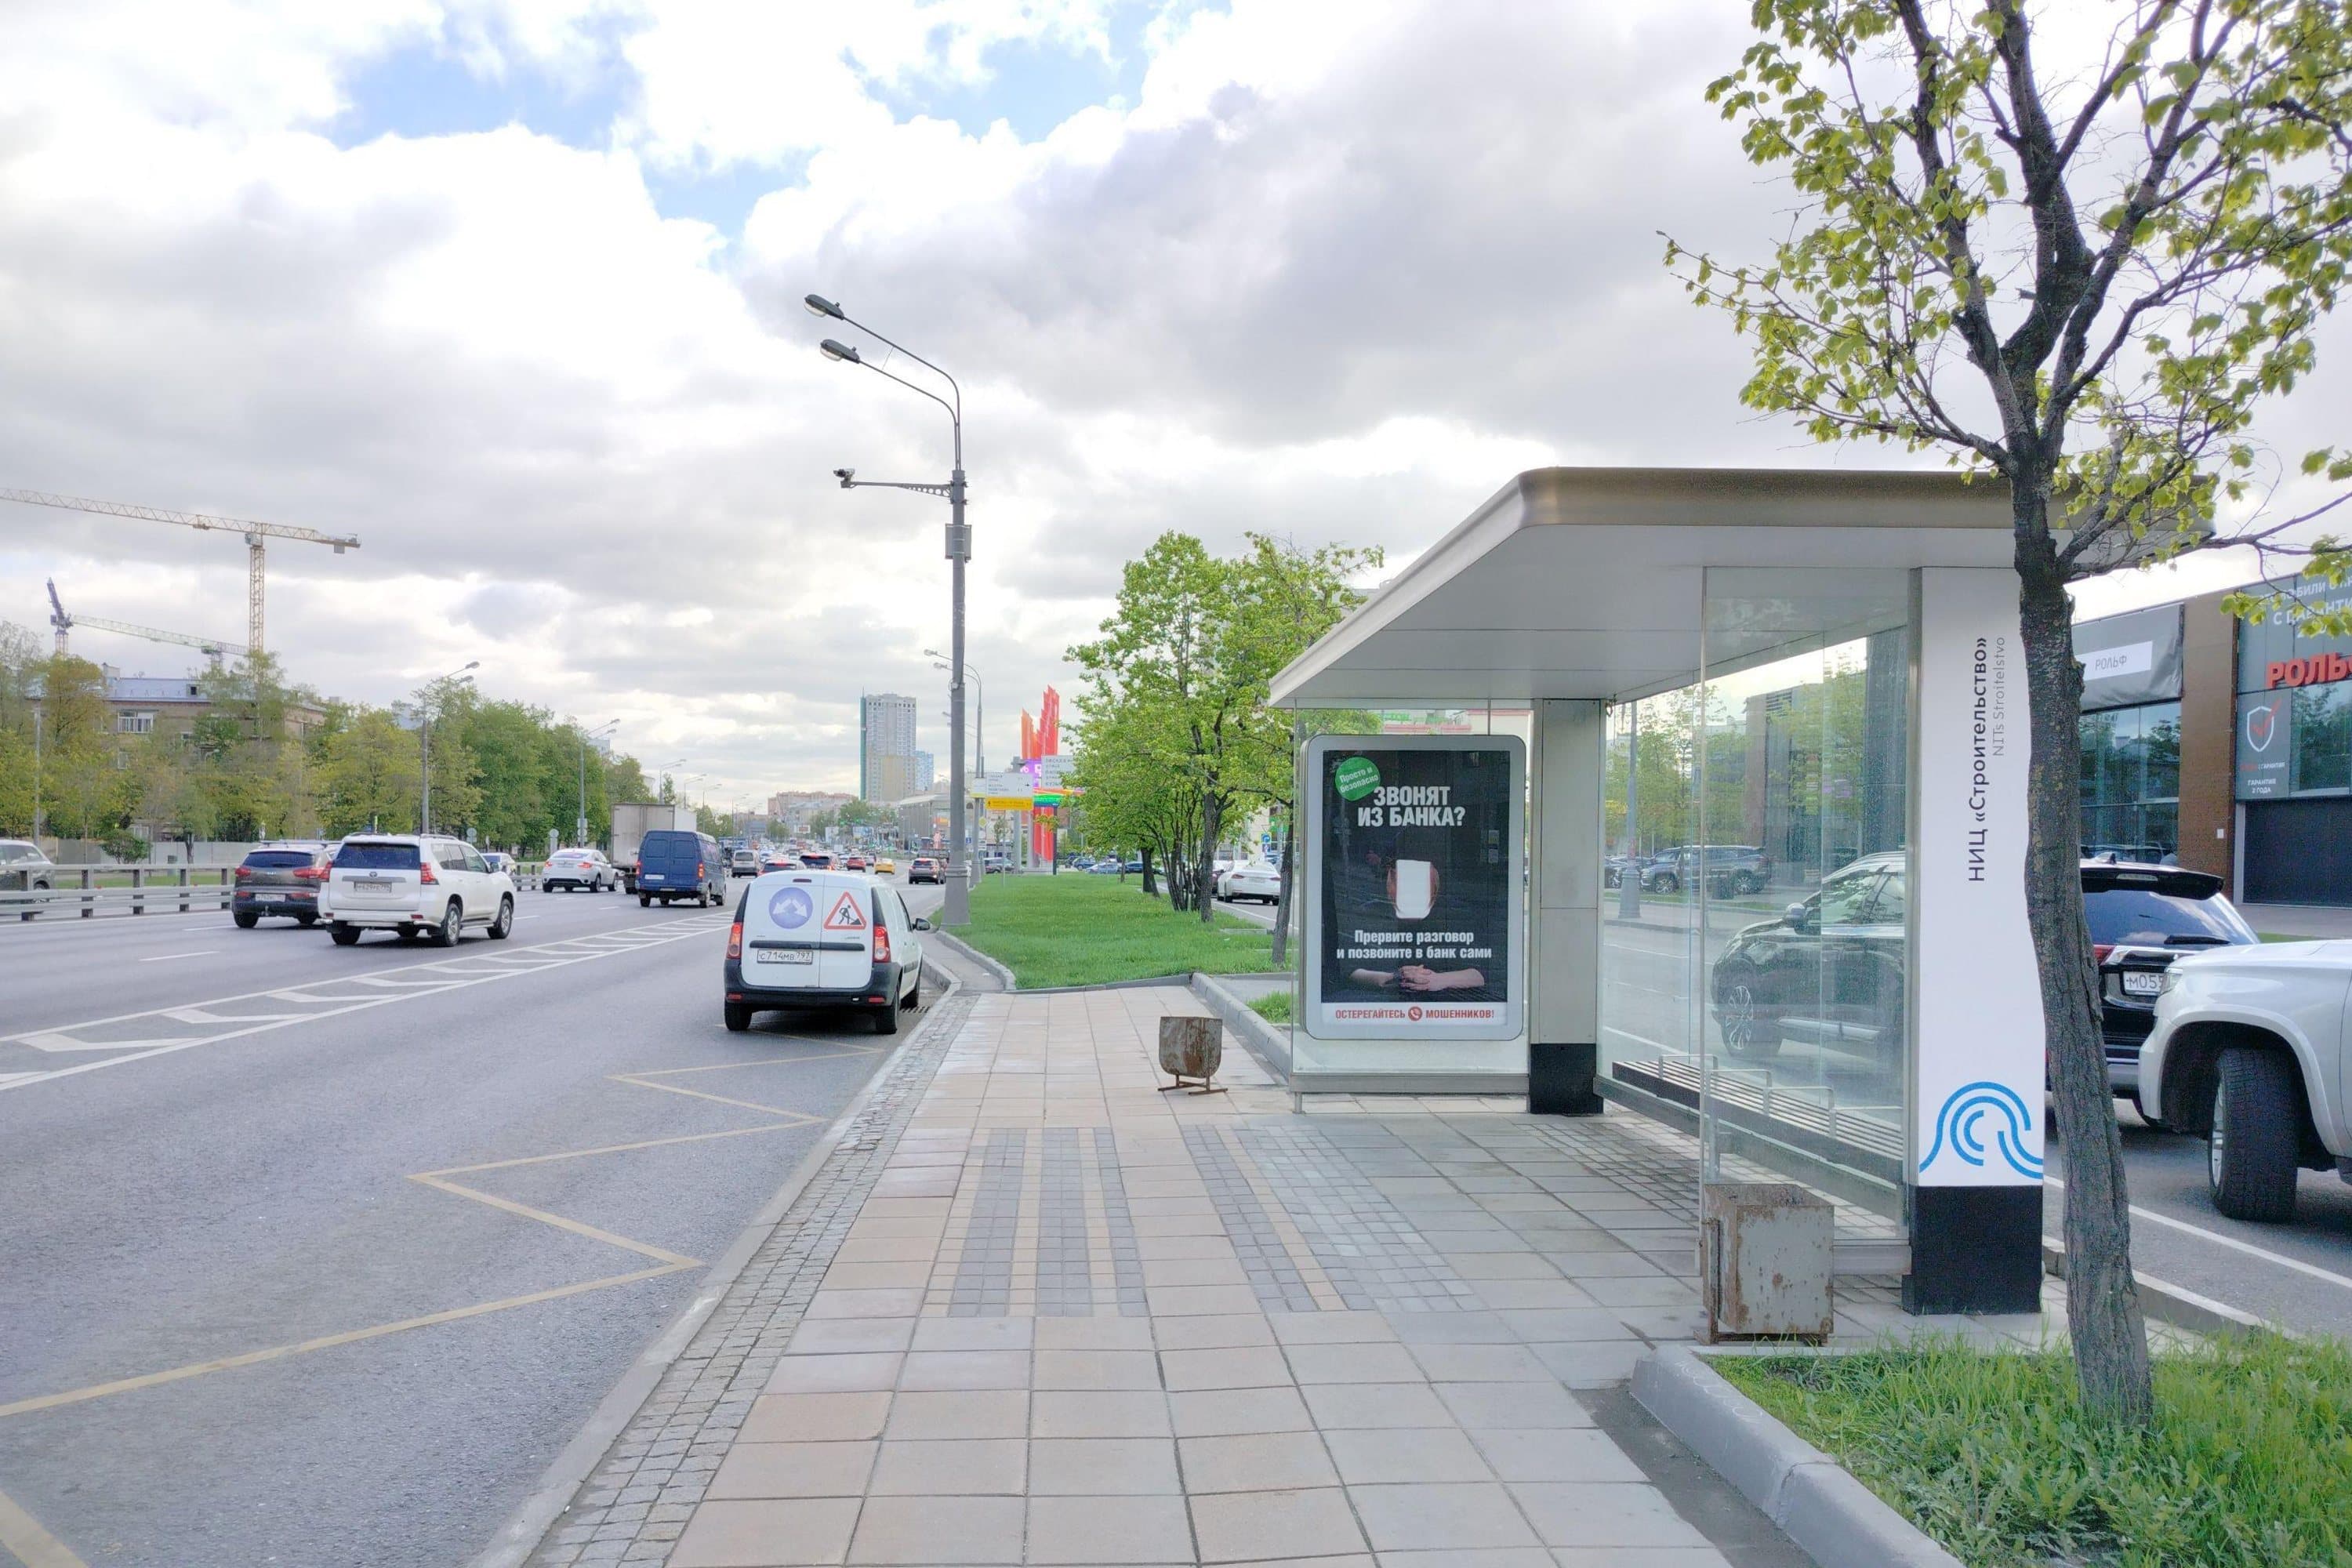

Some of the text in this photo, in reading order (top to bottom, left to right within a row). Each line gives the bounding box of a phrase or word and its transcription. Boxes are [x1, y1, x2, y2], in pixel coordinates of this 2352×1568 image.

[2095, 655, 2127, 671] РОЛЬФ
[2265, 652, 2352, 690] РОЛЬ
[1992, 637, 2005, 720] Stroitelstvo
[1968, 637, 1990, 882] НИЦ «Строительство»
[1339, 767, 1373, 783] Просто и
[1340, 774, 1379, 793] безопасно
[1374, 786, 1450, 807] ЗВОНЯТ
[1357, 806, 1466, 827] ИЗ БАНКА?
[1354, 929, 1475, 946] Прервите разговор
[1336, 946, 1492, 960] и позвоните в банк сами
[1335, 1007, 1494, 1020] ОСТЕРЕГАЙТЕСЬ МОШЕННИКОВ!
